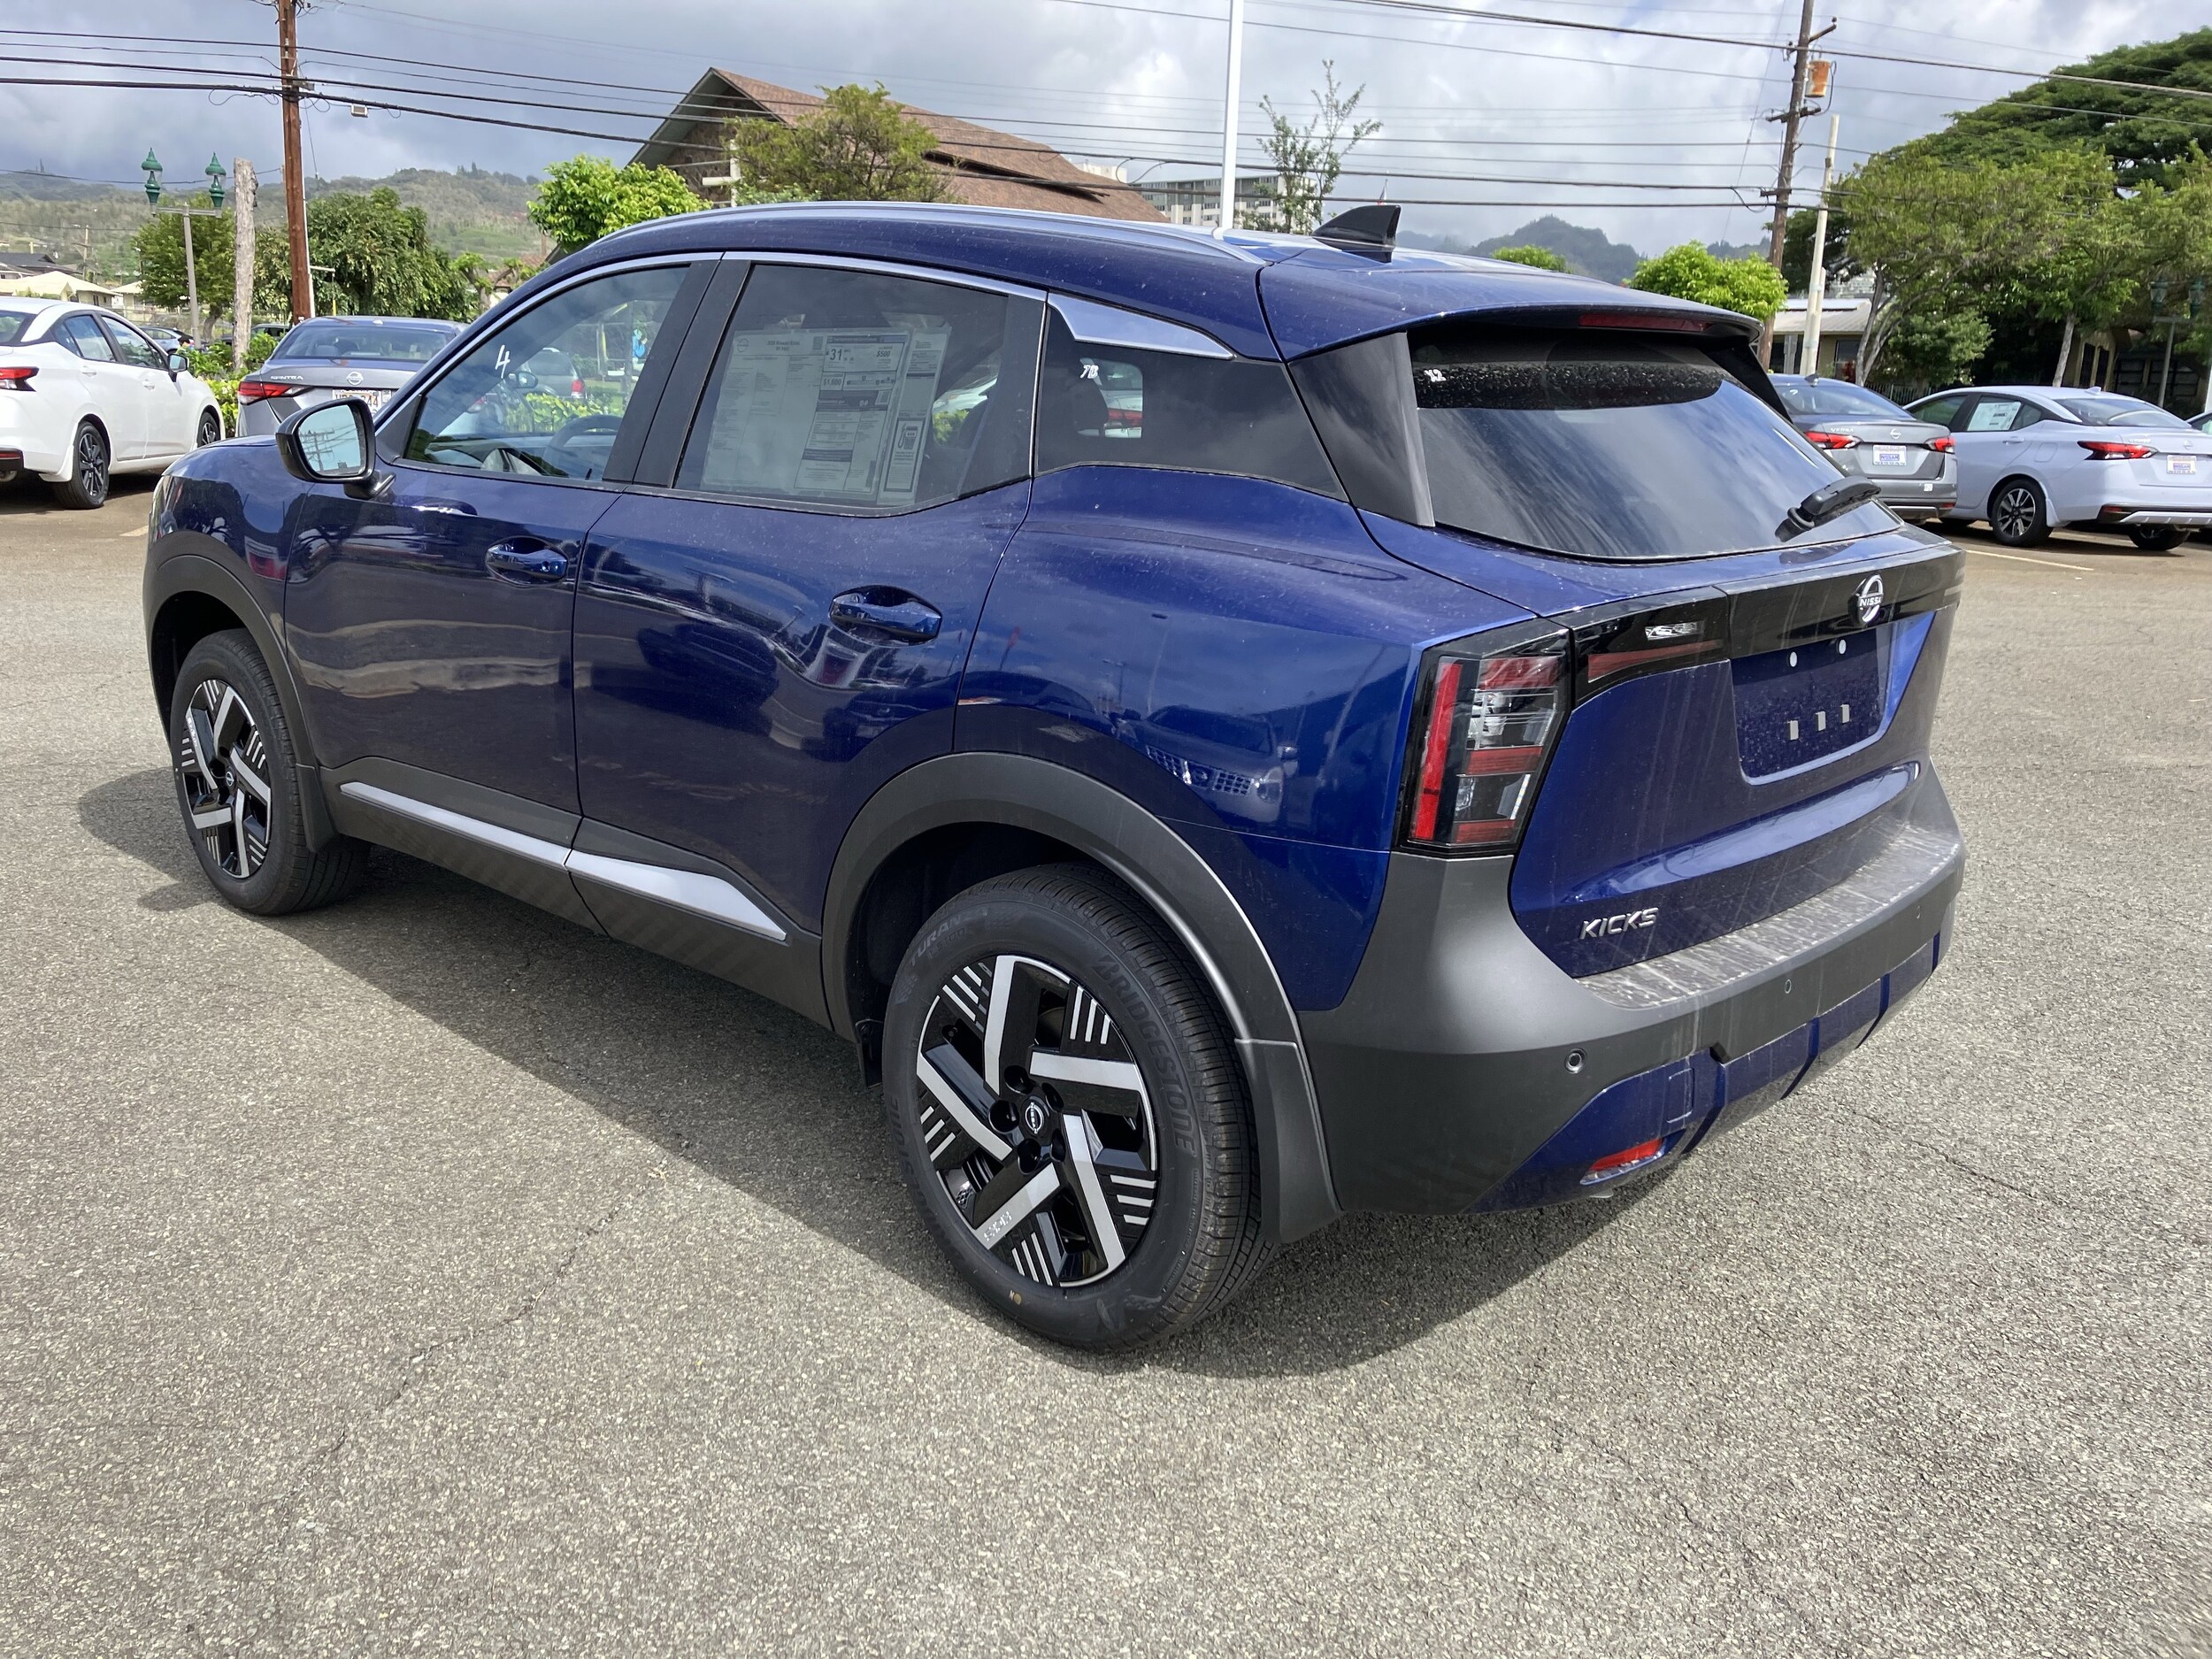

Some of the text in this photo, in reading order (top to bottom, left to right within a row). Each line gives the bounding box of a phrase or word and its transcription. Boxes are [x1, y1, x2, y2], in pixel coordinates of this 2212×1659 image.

[495, 344, 511, 379] 4
[830, 348, 842, 361] 31
[1579, 907, 1659, 940] KICKS
[1092, 955, 1196, 1155] BRIDGESTONE
